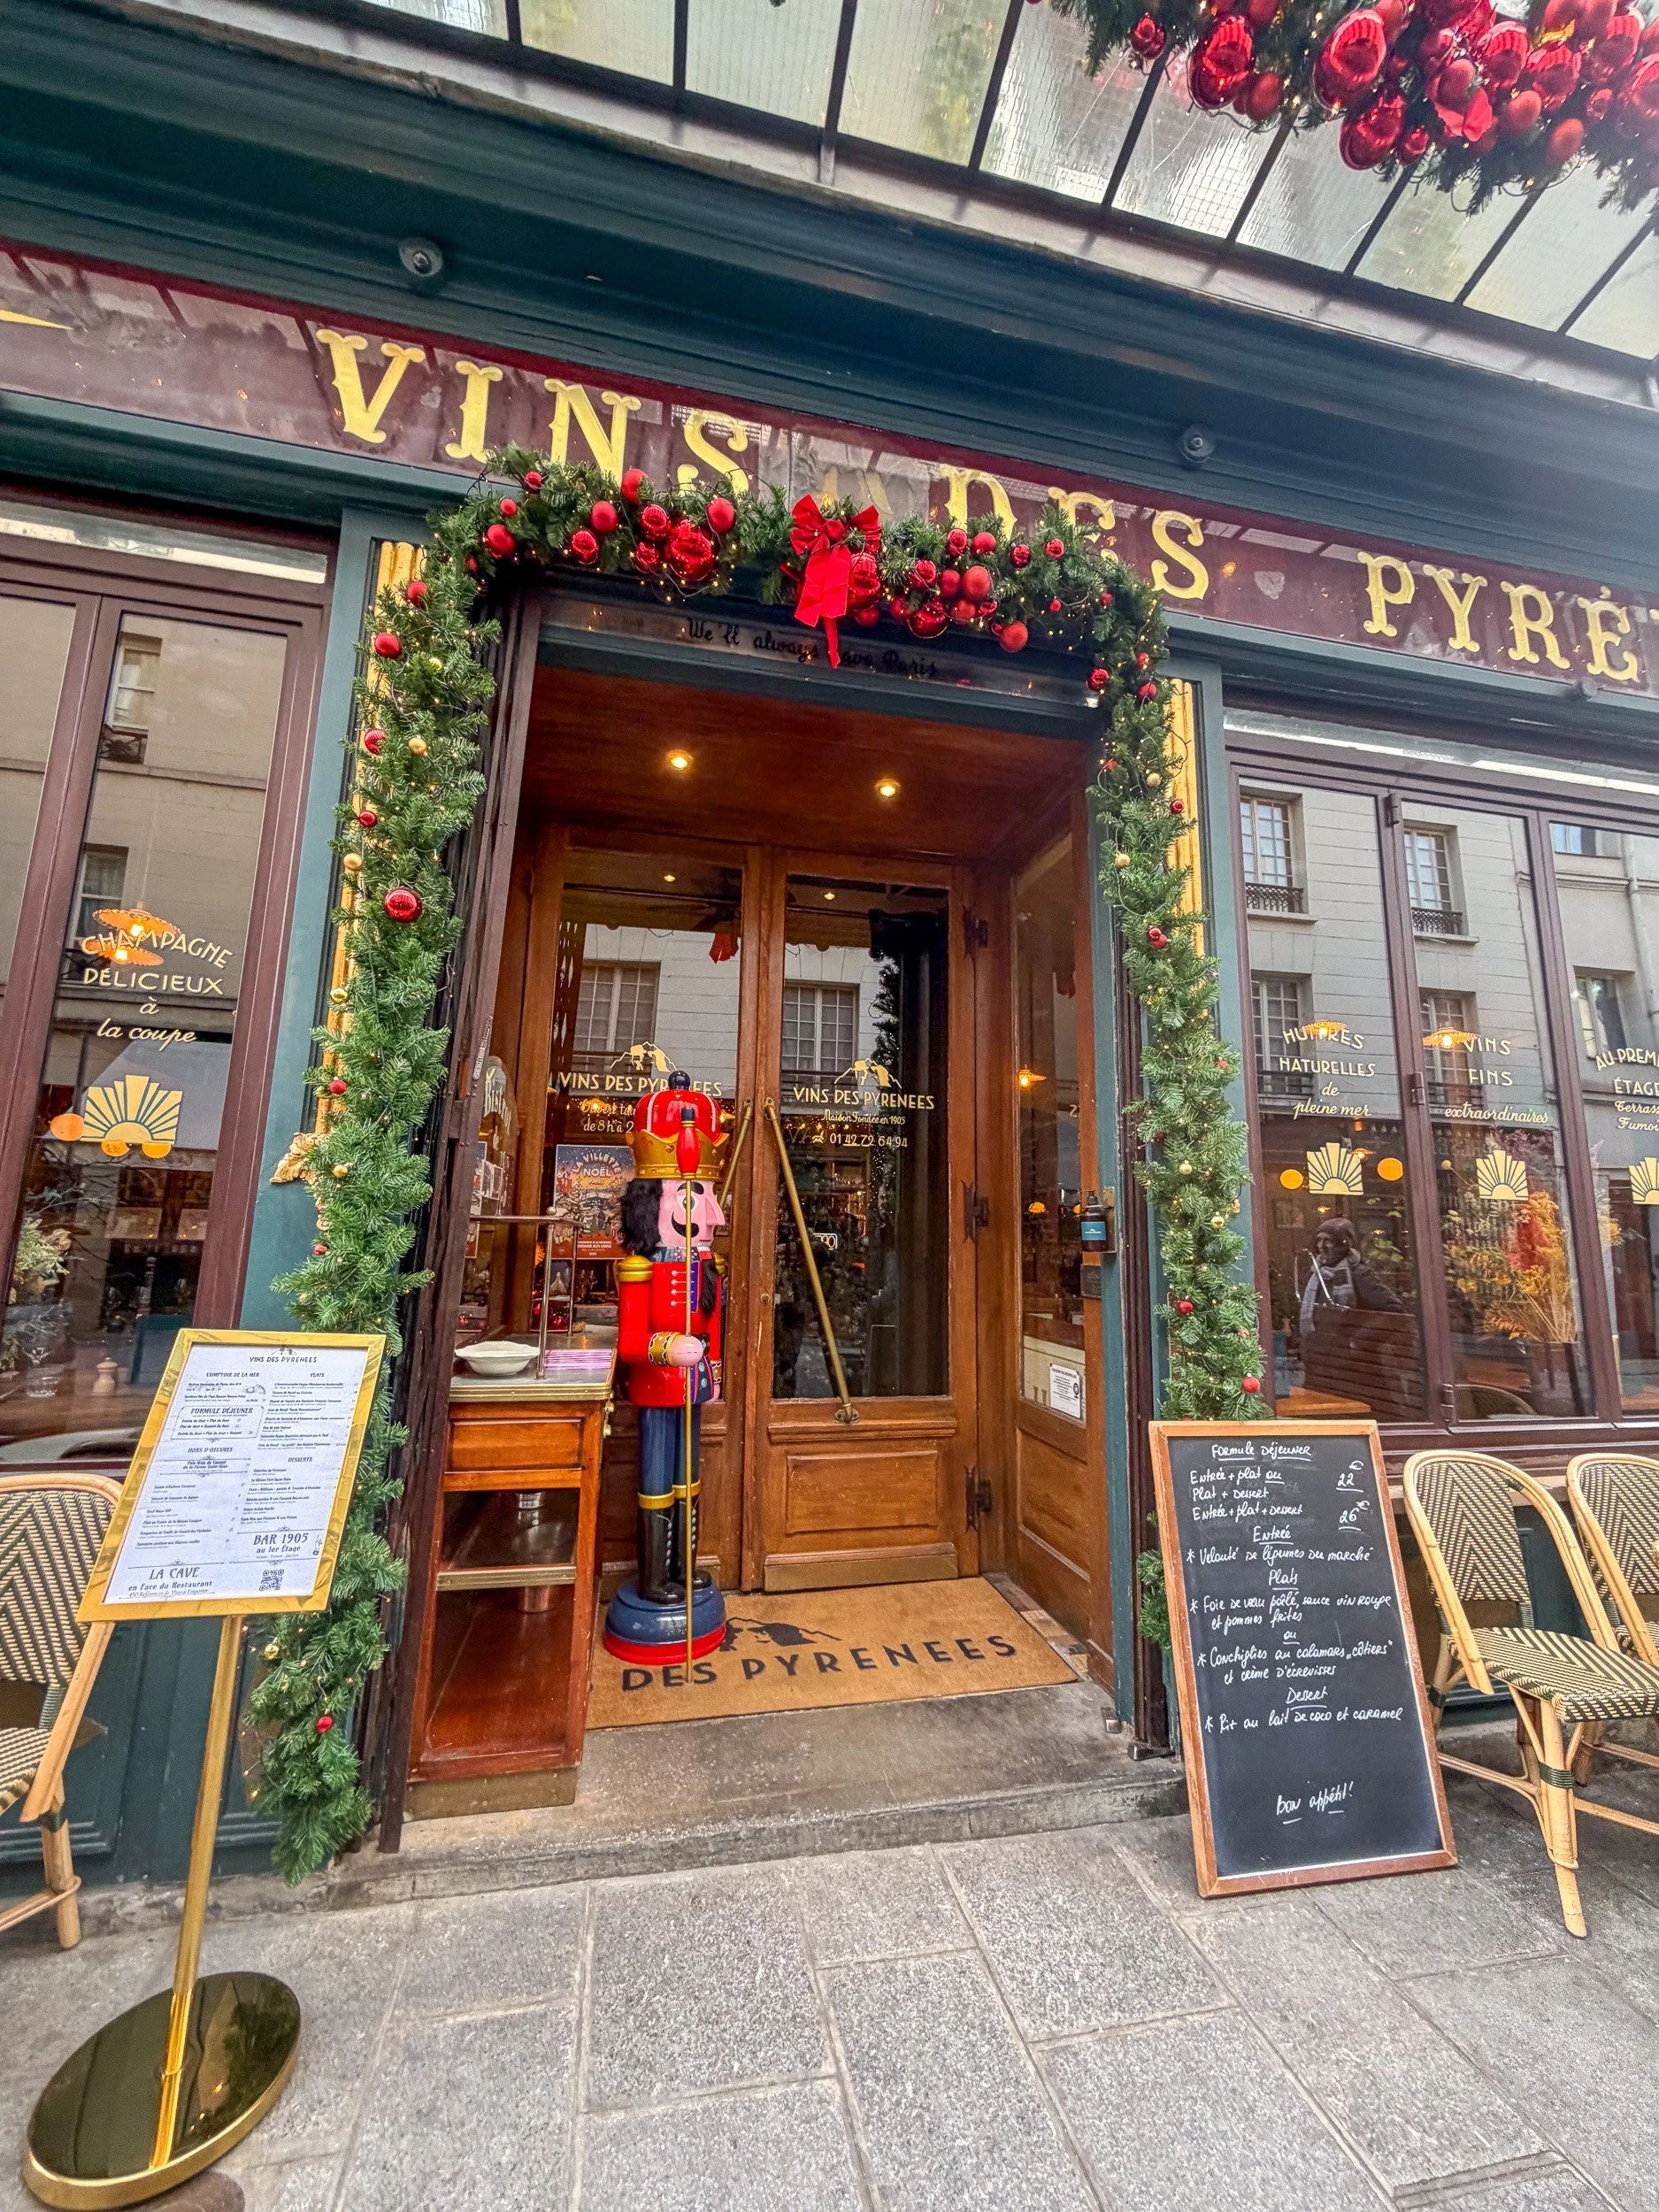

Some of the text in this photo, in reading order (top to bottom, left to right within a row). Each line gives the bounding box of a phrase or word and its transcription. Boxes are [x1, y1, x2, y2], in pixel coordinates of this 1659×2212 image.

[316, 328, 749, 495] VINS
[1357, 549, 1659, 682] PYRÉ
[687, 617, 741, 647] We'll
[753, 630, 819, 662] always
[882, 647, 937, 676] Paris
[81, 929, 234, 969] CHAMPAGNE
[83, 967, 225, 995] DÉLICIEUX
[139, 996, 160, 1015] à
[96, 1018, 197, 1052] la coupe
[1463, 1036, 1511, 1056] VINS
[1279, 1056, 1376, 1078] NATURELLES
[1595, 1049, 1616, 1071] AU
[559, 1071, 722, 1097] VINS DES PYREES
[1469, 1068, 1513, 1087] FINS
[1322, 1081, 1340, 1096] de
[793, 1087, 935, 1110] VINS DES PYRENEES
[821, 1108, 906, 1125] Maison Fondée en 1905
[1293, 1097, 1372, 1120] pleine mer
[1444, 1101, 1548, 1124] extraordinaires
[583, 1119, 597, 1133] de
[617, 1120, 624, 1133] à
[829, 1133, 908, 1148] 01 42 72 64 94
[582, 1152, 622, 1175] VILLETTE
[583, 1166, 611, 1178] NOËL
[1190, 1467, 1226, 1485] Entrée
[1236, 1466, 1261, 1485] plat
[1265, 1471, 1282, 1480] ou
[1193, 1487, 1217, 1502] Plat
[253, 1532, 309, 1546] BAR 1905
[1253, 1525, 1291, 1543] Entrée
[1199, 1546, 1240, 1565] Velouté
[1263, 1544, 1305, 1566] légumes
[149, 1567, 200, 1579] LA CAVE
[1268, 1568, 1298, 1586] Plats
[172, 1580, 212, 1589] Restaurant
[1203, 1595, 1225, 1612] Foie
[1243, 1599, 1265, 1609] veau
[1302, 1595, 1330, 1606] sauce
[1224, 1615, 1263, 1635] pommes
[1271, 1608, 1302, 1628] frites
[1283, 1630, 1297, 1640] ou
[621, 1633, 1018, 1692] DES PYRENEES
[1286, 1686, 1328, 1704] Dessert
[1243, 1718, 1258, 1728] au
[1268, 1707, 1290, 1725] lait
[1336, 1707, 1349, 1720] et
